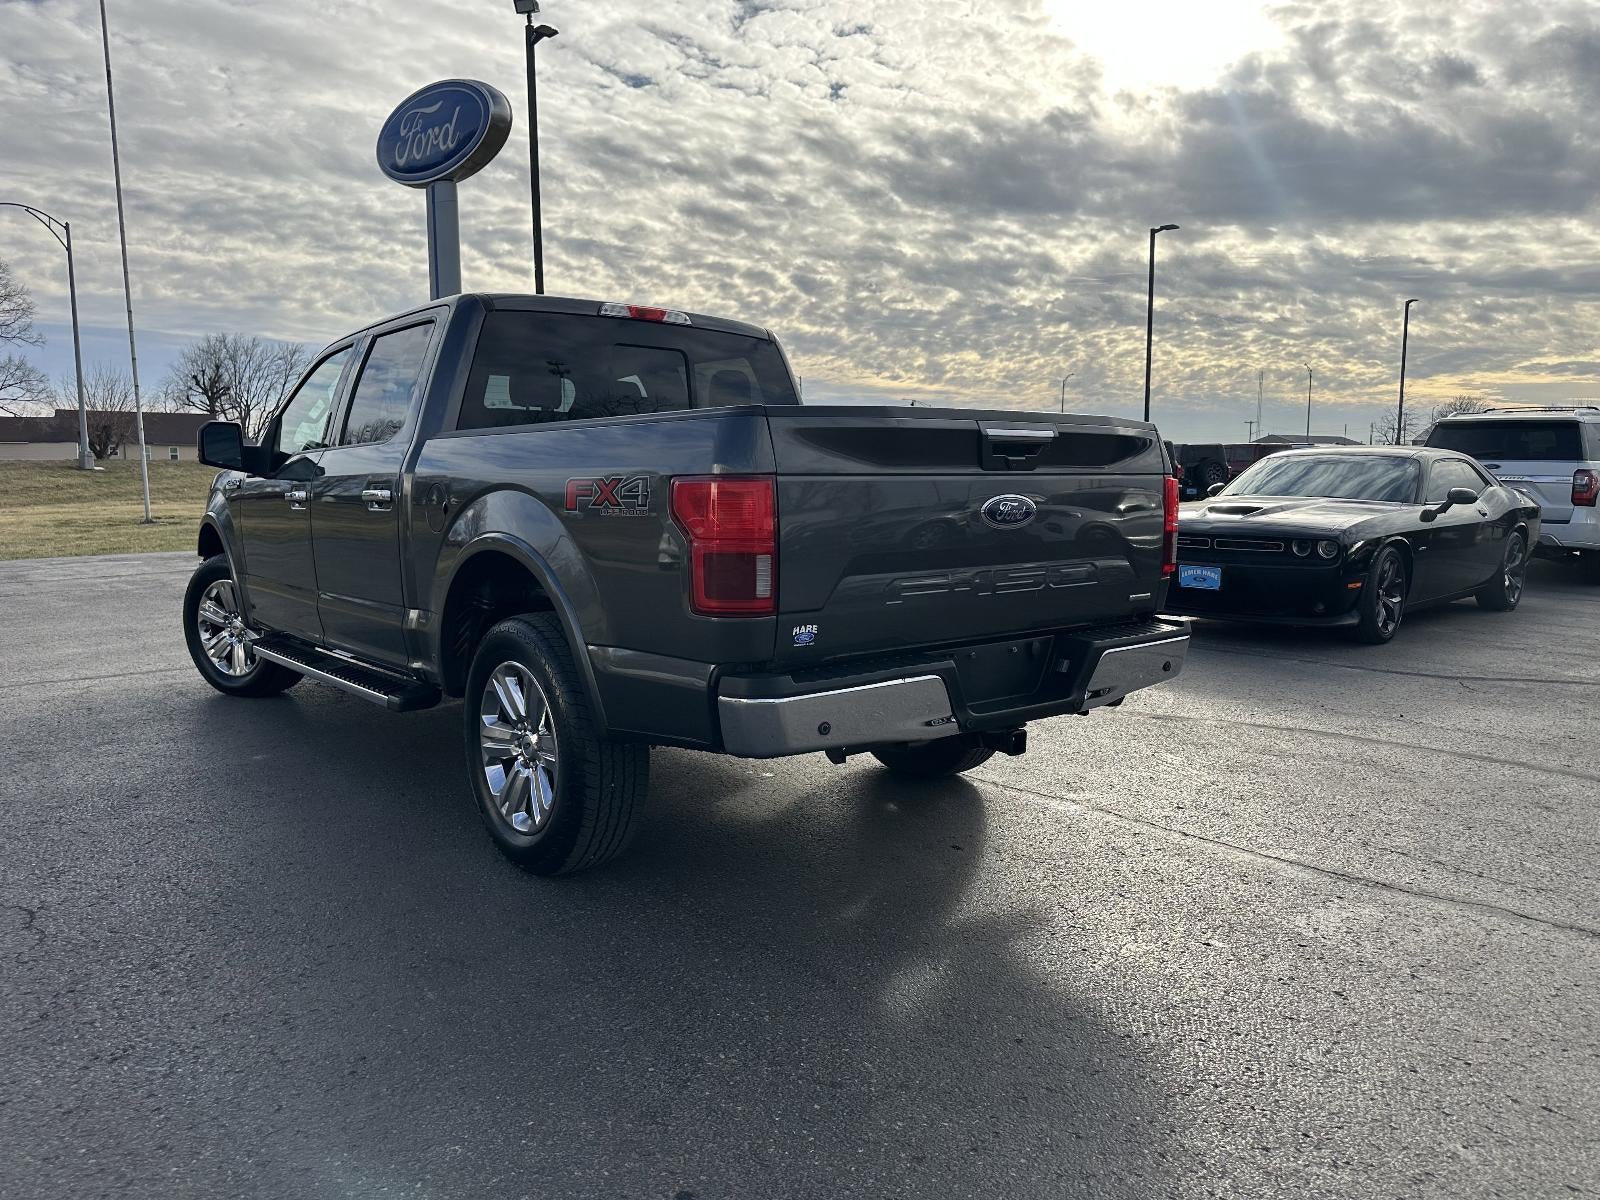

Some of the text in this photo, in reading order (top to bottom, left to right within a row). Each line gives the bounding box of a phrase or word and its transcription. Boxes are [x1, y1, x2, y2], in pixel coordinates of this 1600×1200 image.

[395, 100, 461, 166] Ford
[564, 475, 650, 513] FX4
[996, 501, 1026, 520] Ford
[792, 624, 818, 636] HARE
